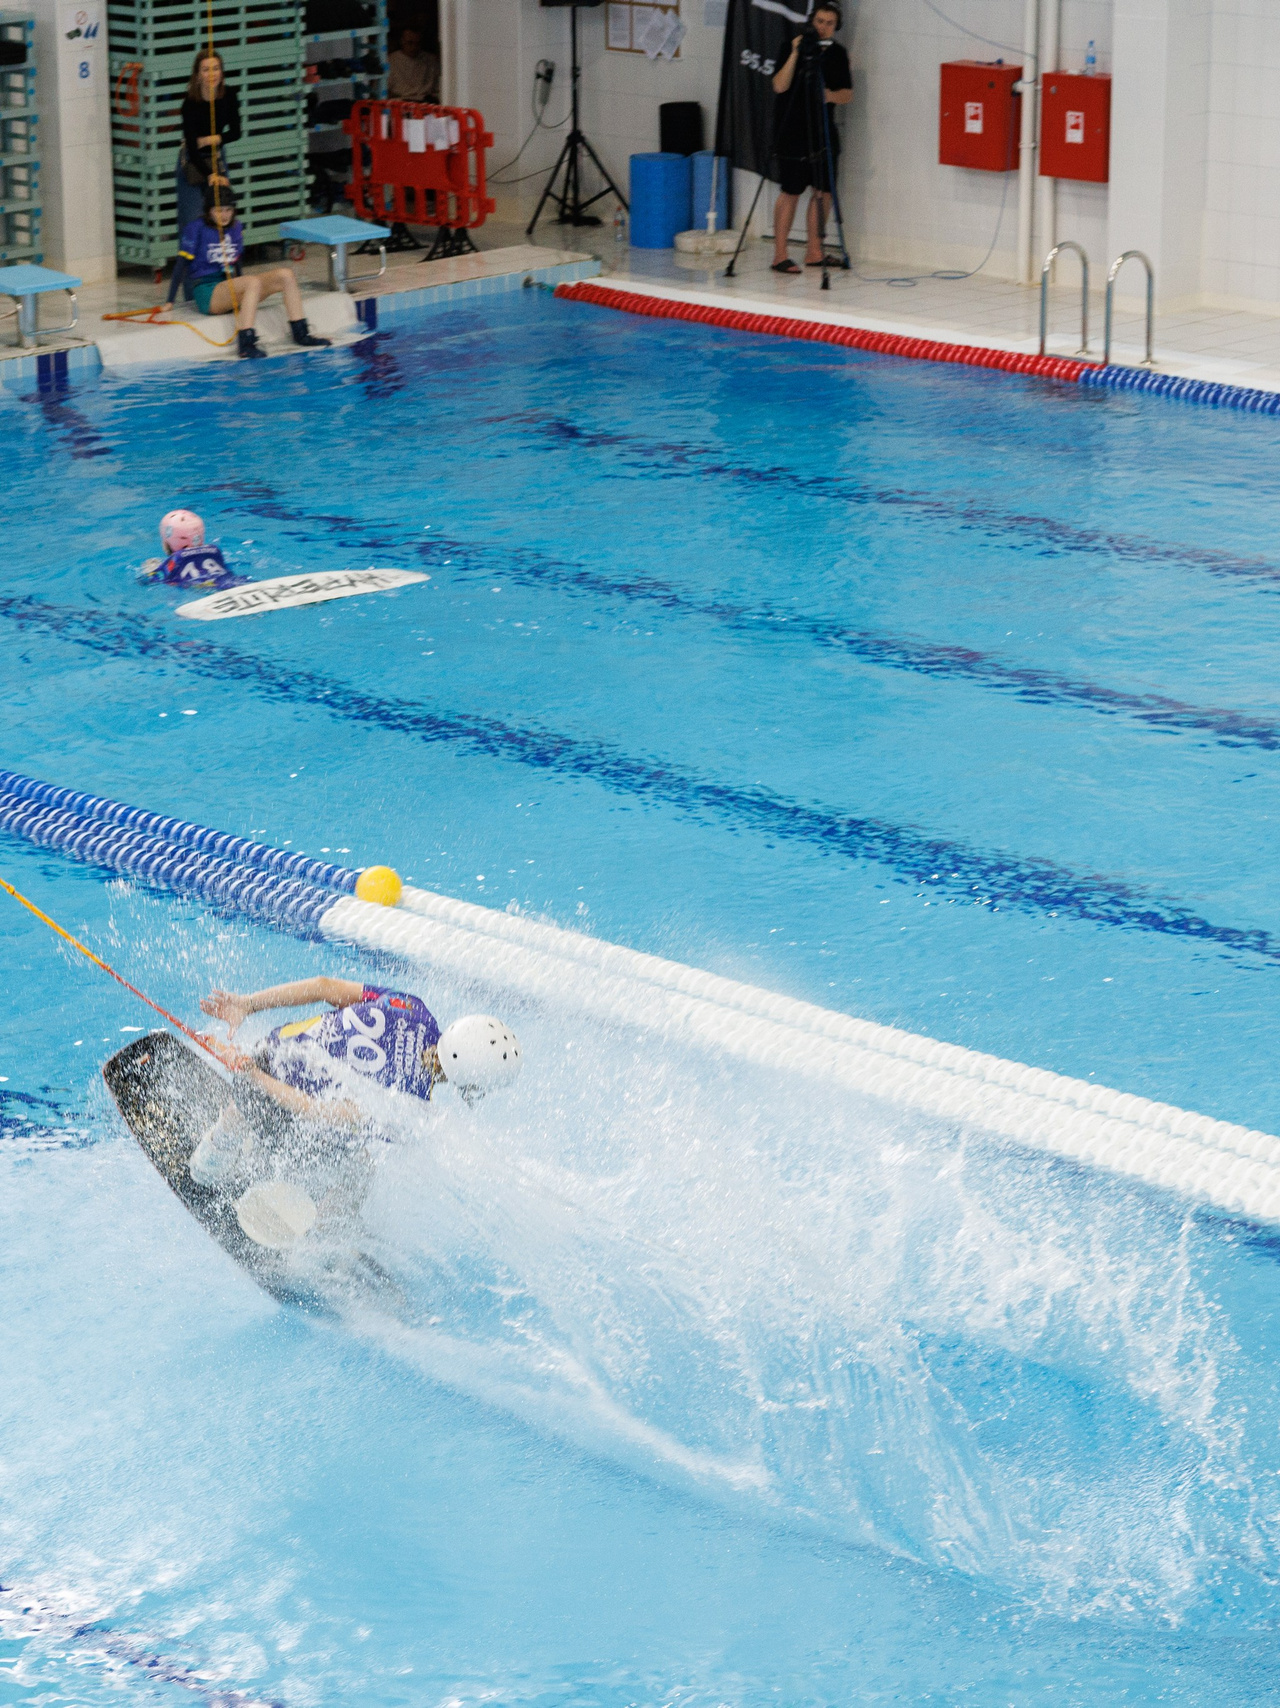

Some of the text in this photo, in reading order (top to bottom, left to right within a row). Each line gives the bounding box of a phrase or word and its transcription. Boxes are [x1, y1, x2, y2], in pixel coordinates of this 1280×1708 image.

[79, 61, 90, 79] 8
[740, 49, 776, 75] 95.5
[342, 1006, 387, 1074] 20
